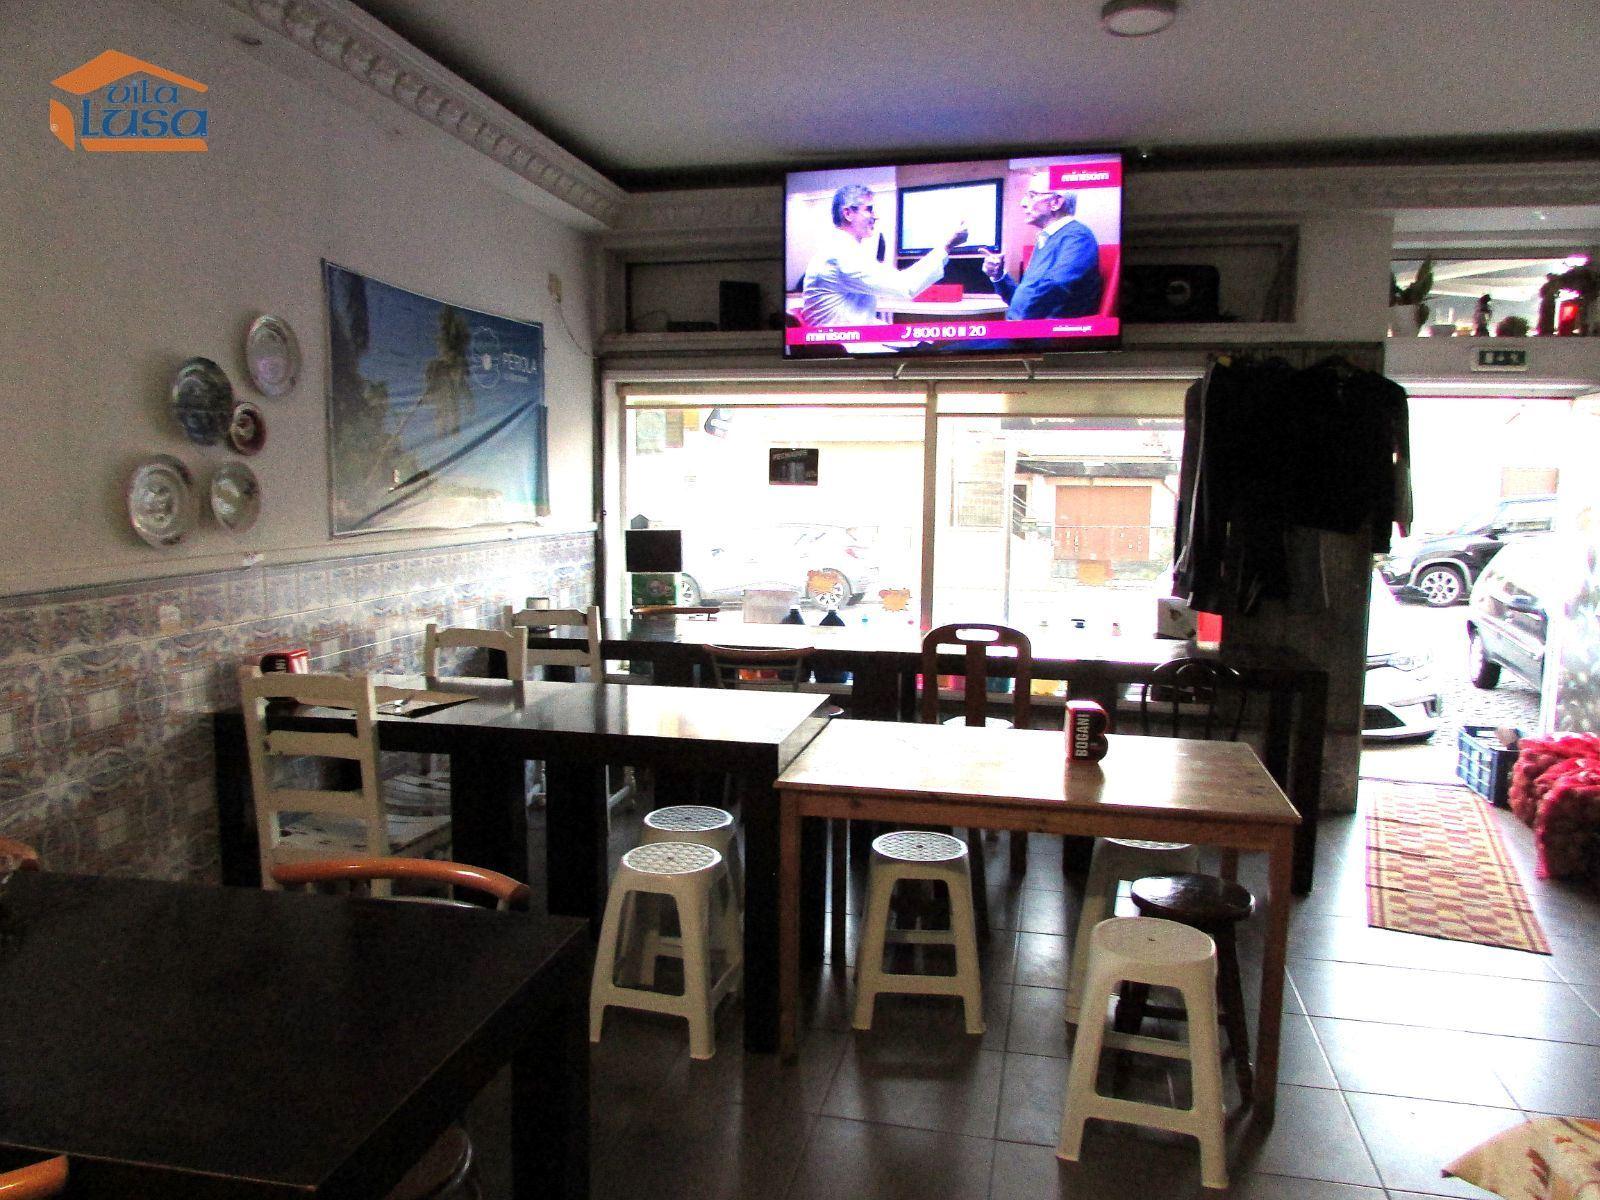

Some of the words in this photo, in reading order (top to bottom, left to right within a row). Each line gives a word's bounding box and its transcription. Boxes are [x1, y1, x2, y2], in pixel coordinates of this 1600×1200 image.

[1061, 171, 1110, 182] minisom
[805, 328, 861, 342] minisom
[912, 326, 941, 338] 800
[968, 325, 987, 337] 20
